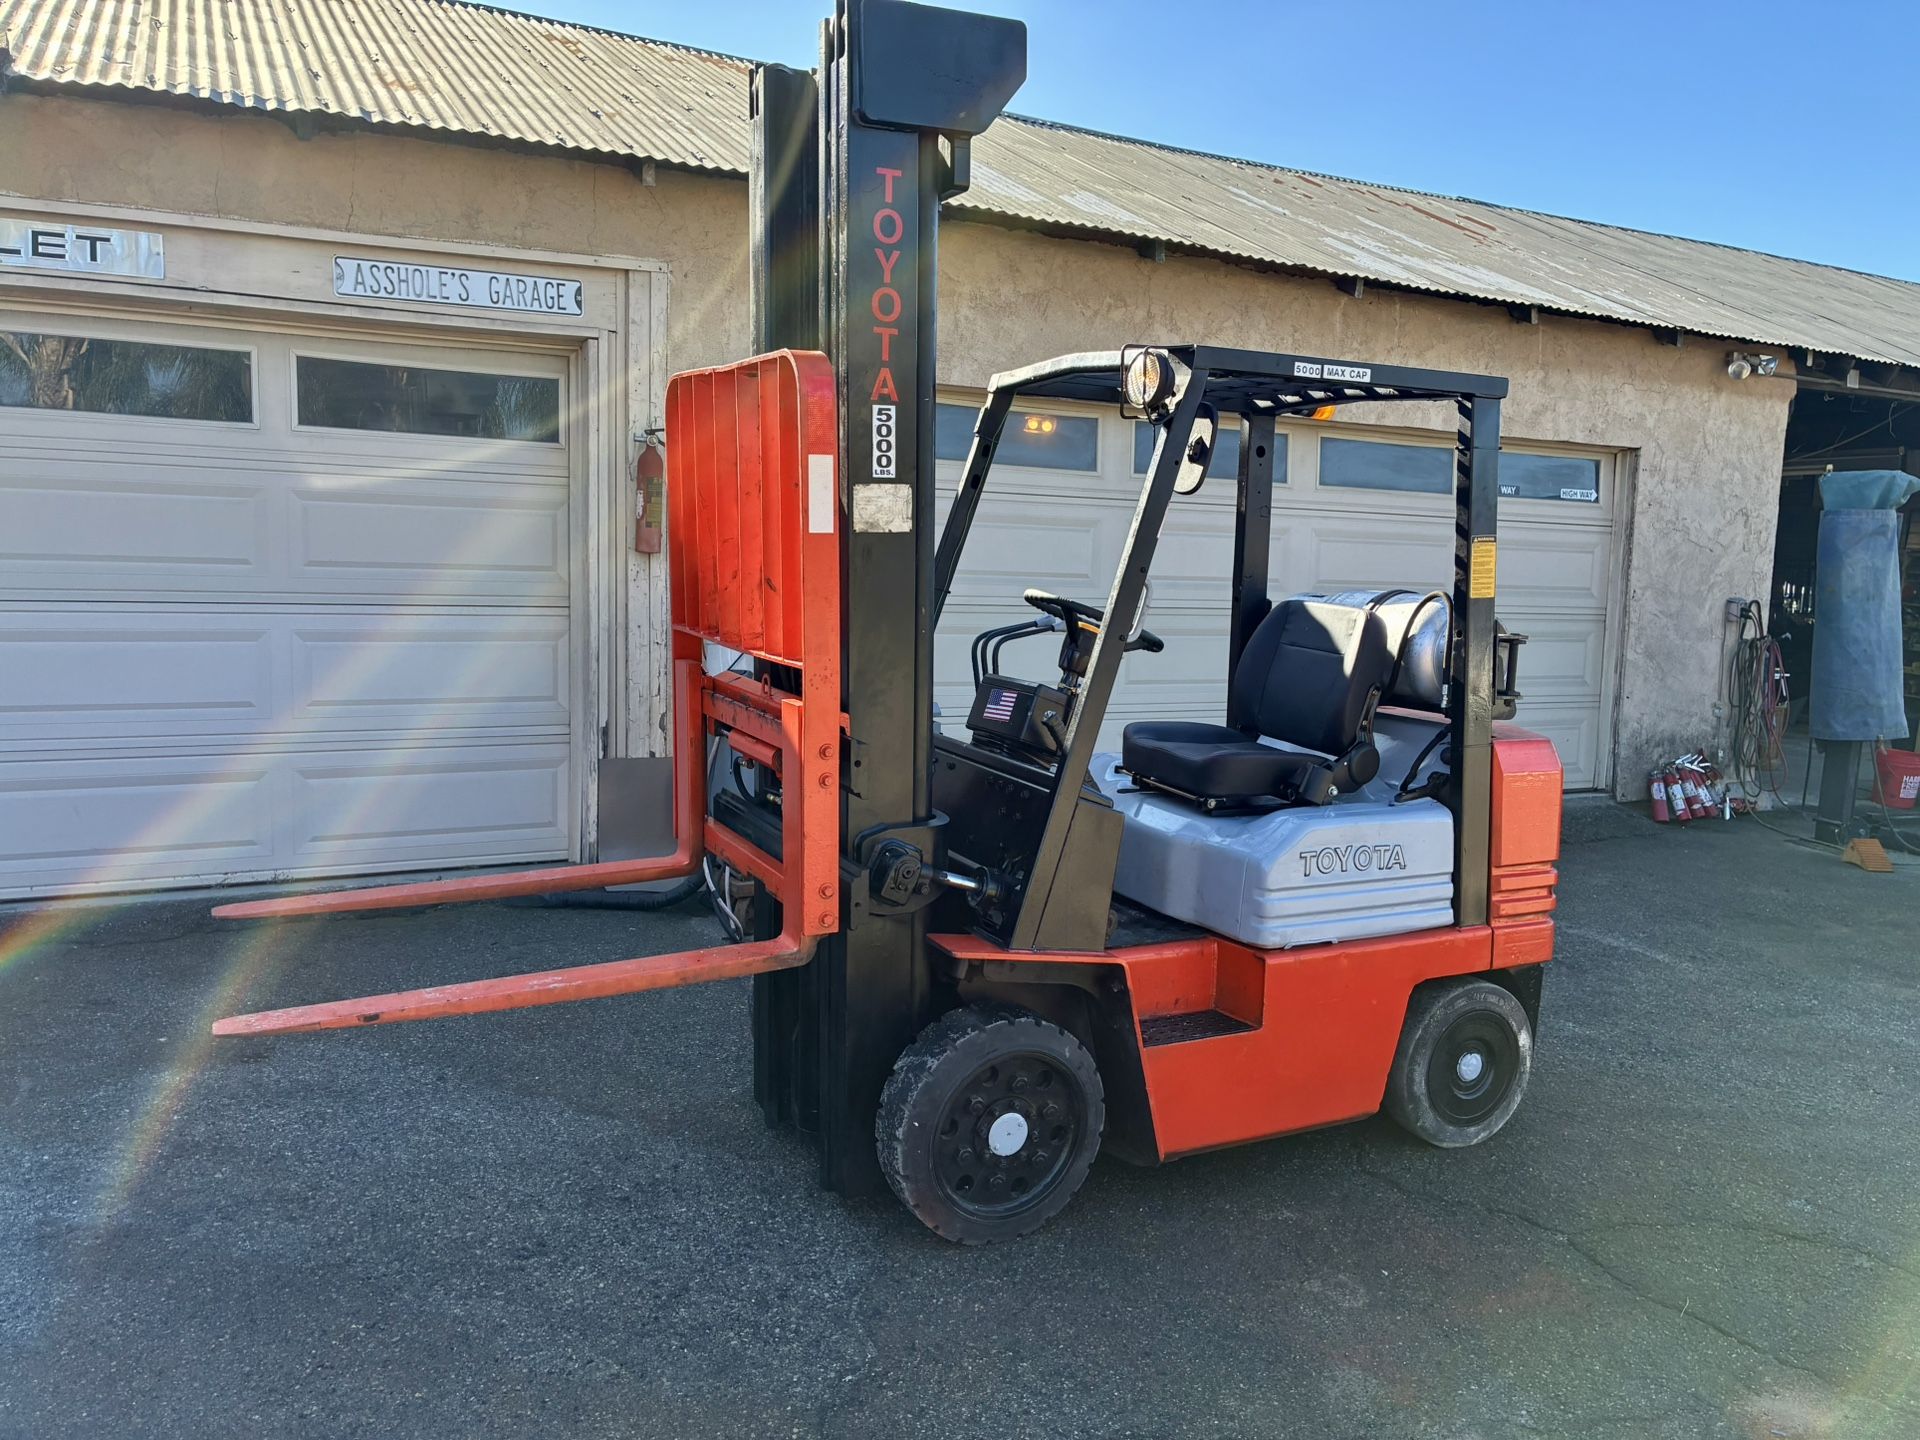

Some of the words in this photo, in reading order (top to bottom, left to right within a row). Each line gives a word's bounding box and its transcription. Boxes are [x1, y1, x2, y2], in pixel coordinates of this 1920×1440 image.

[353, 263, 470, 302] ASSHOLE'S
[489, 276, 567, 311] GARAGE
[871, 167, 903, 401] TOYOTA
[1295, 365, 1320, 376] 5000
[1326, 367, 1346, 378] MAX
[1349, 369, 1368, 380] CAP
[876, 408, 892, 468] 5000
[1500, 485, 1516, 495] WAY
[1562, 489, 1578, 498] HIGH
[1579, 491, 1592, 499] WAY
[1300, 844, 1407, 877] TOYOTA
